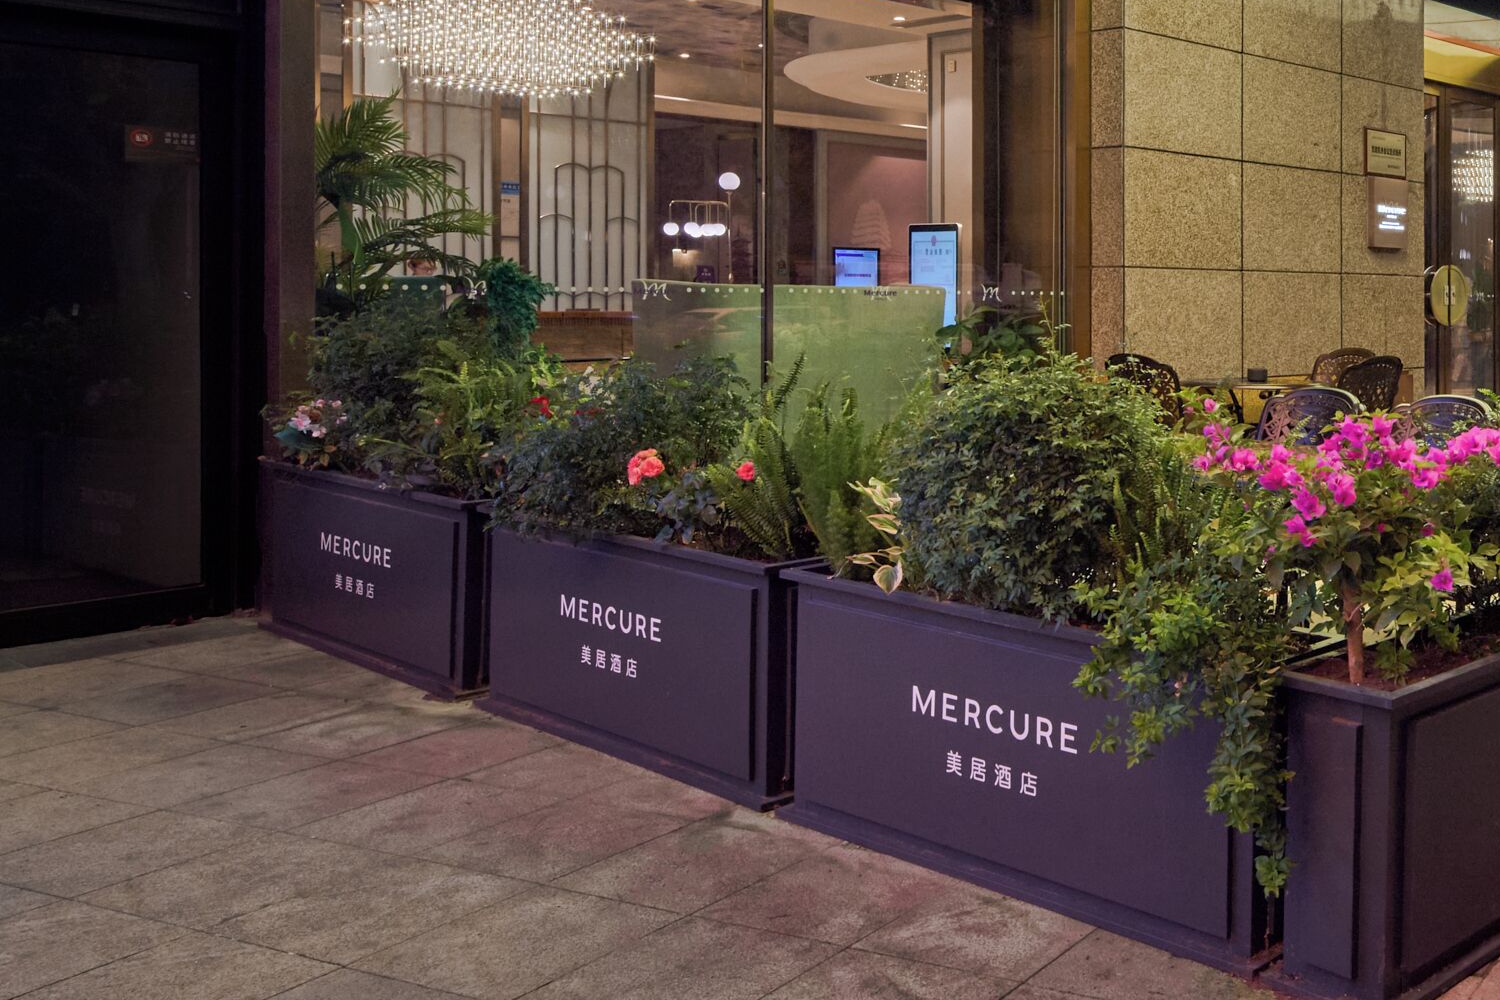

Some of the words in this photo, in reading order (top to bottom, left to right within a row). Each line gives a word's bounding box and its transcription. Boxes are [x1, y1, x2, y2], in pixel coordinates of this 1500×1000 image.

[320, 531, 392, 569] MERCURE
[334, 573, 376, 600] 美居酒店
[559, 593, 663, 643] MERCURE
[580, 644, 639, 679] 美居酒店
[911, 684, 1079, 755] MERCURE
[945, 749, 1038, 797] 美居酒店
